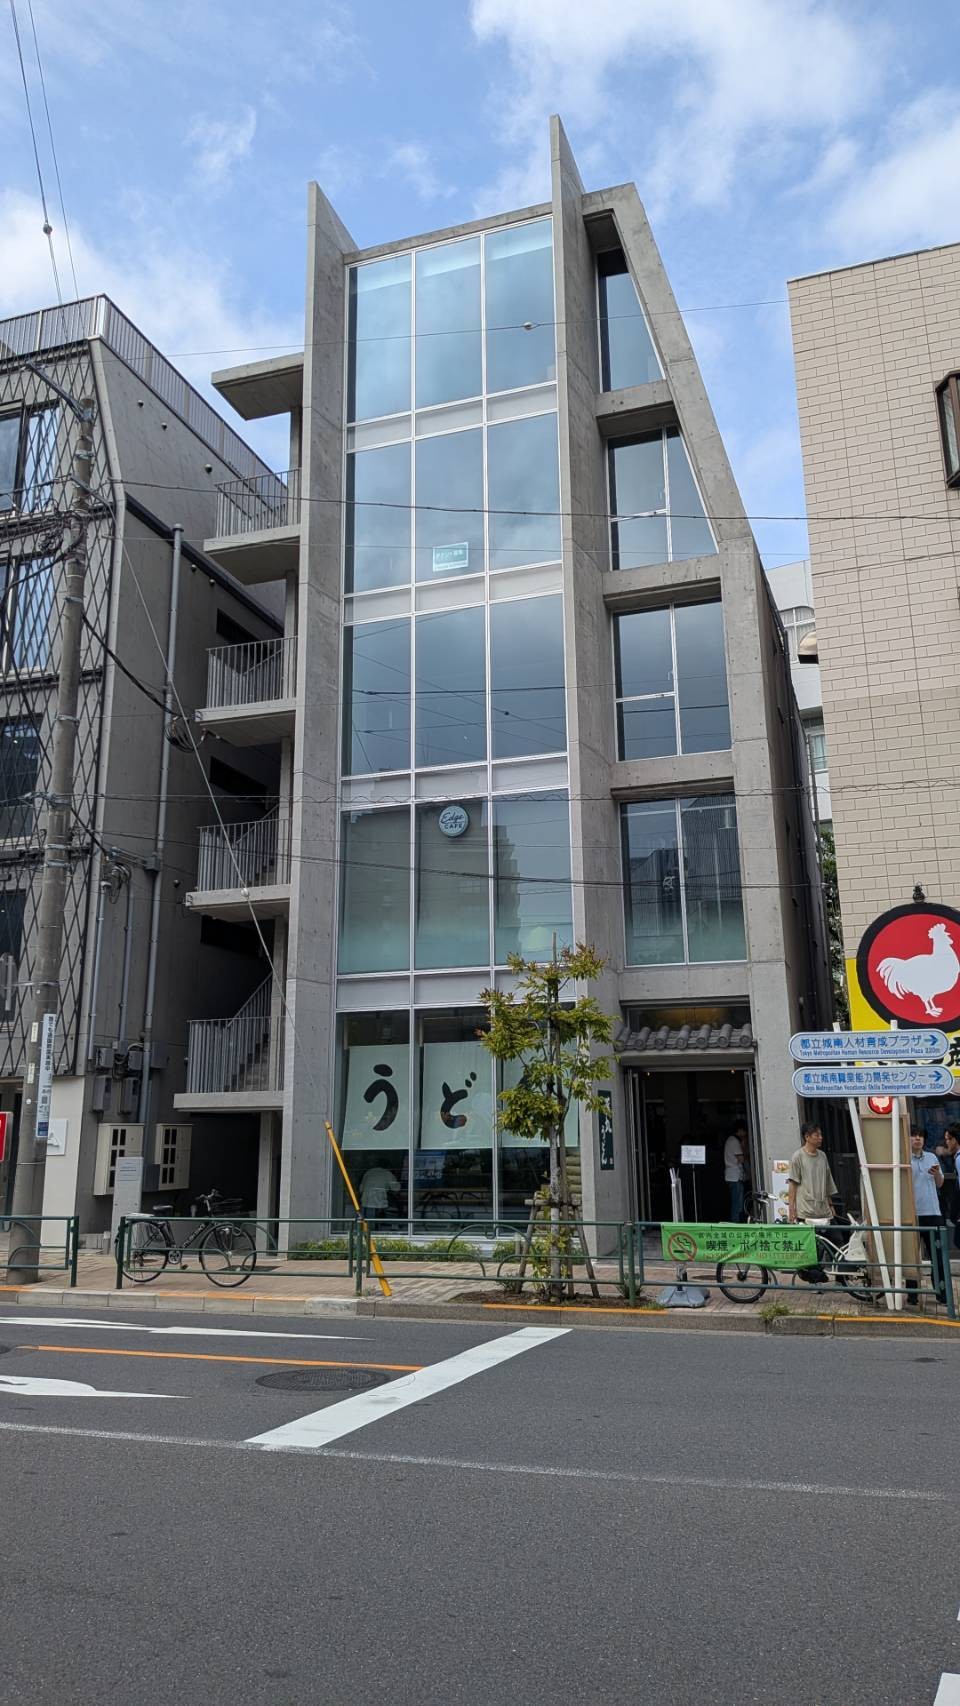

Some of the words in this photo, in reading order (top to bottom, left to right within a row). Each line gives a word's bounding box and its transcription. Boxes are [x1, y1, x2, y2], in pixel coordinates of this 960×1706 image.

[440, 811, 465, 824] Edge
[800, 1035, 922, 1050] 都立城南人材育成プラザ
[803, 1071, 926, 1084] 都立城南職業能力開発センター
[705, 1240, 805, 1252] 喫煙・ポイ捨て禁止
